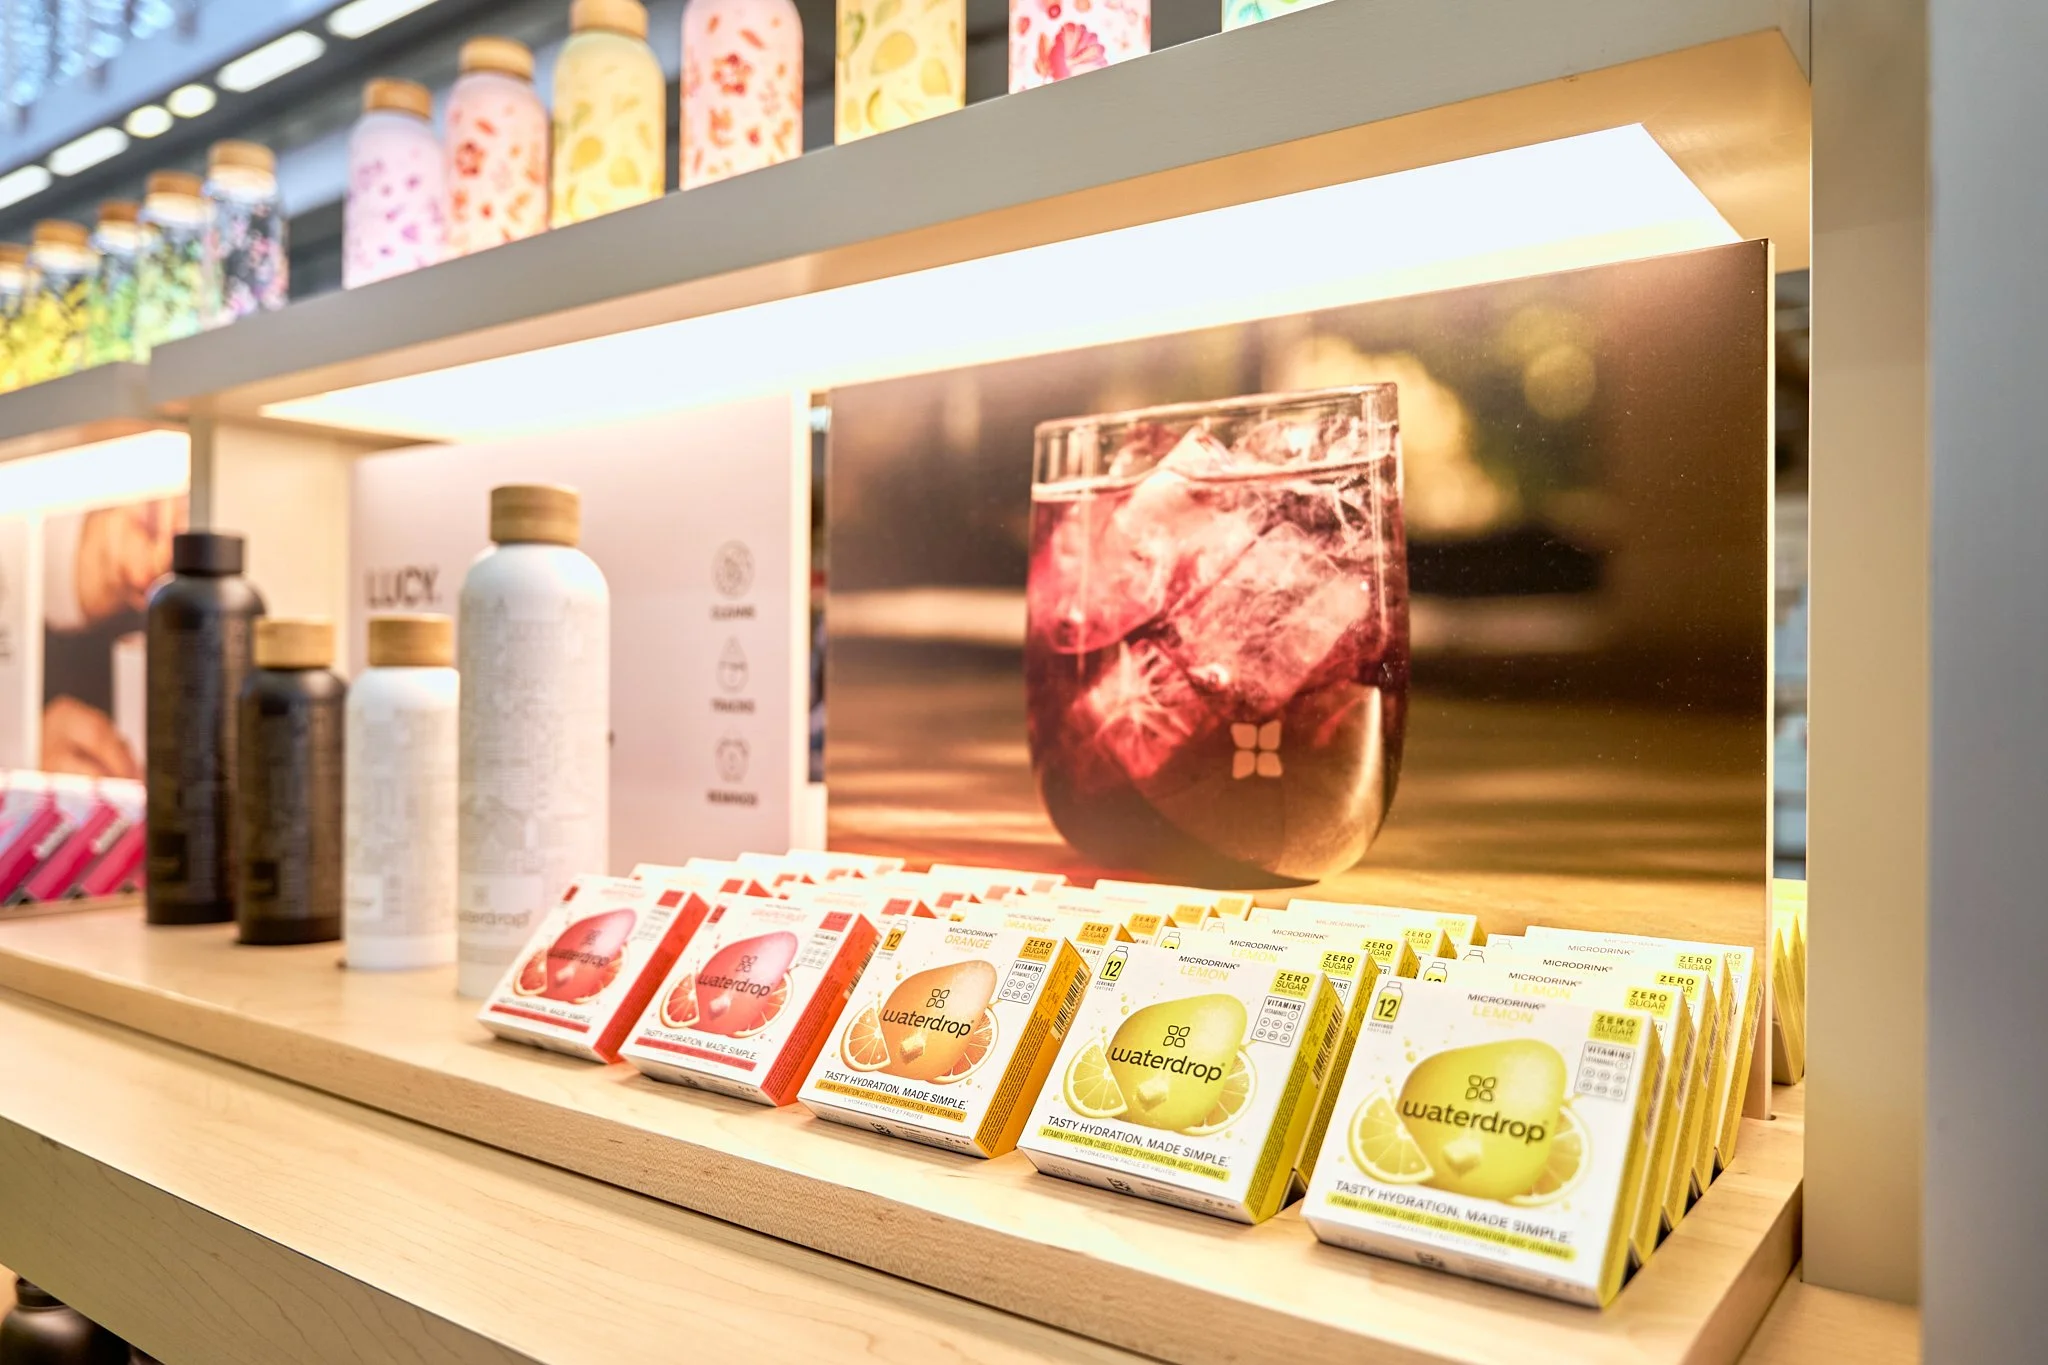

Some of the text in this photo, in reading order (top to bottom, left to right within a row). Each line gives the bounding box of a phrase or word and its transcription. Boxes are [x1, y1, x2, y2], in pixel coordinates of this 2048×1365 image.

[1082, 930, 1106, 940] SUGAR
[1085, 925, 1109, 933] ZERO
[1405, 930, 1432, 939] ZERO
[886, 933, 901, 948] 12
[944, 934, 993, 950] ORANGE
[1028, 940, 1053, 949] ZERO
[1365, 941, 1393, 951] ZERO
[1024, 946, 1050, 956] SUGAR
[1325, 953, 1355, 964] ZERO
[1680, 955, 1712, 965] ZERO
[1015, 963, 1043, 973] VITAMINS
[1105, 960, 1122, 977] 12
[1180, 965, 1231, 981] LEMON
[1322, 961, 1353, 972] SUGAR
[1678, 963, 1711, 972] SUGAR
[1279, 973, 1310, 984] ZERO
[1660, 975, 1694, 986] ZERO
[698, 972, 772, 999] waterdrop
[1276, 980, 1307, 992] SUGAR
[1513, 982, 1571, 999] LEMON
[1631, 990, 1668, 1002] ZERO
[1267, 999, 1302, 1012] VITAMINS
[1377, 998, 1397, 1019] 12
[1629, 998, 1666, 1010] SUGAR
[1472, 1005, 1535, 1024] LEMON
[1597, 1014, 1635, 1027] ZERO
[883, 1009, 972, 1039] waterdrop
[1595, 1022, 1633, 1036] SUGAR
[705, 1041, 728, 1053] MADE
[1588, 1045, 1631, 1060] VITAMINS
[1111, 1047, 1223, 1084] waterdrop
[824, 1070, 850, 1083] TASTY
[850, 1076, 900, 1096] HYDRATION,
[902, 1087, 930, 1102] MADE
[819, 1081, 836, 1092] VITAMIN
[924, 1104, 937, 1115] AVEC
[937, 1108, 964, 1121] VITAMINES
[1403, 1100, 1546, 1145] waterdrop
[1048, 1115, 1080, 1131] TASTY
[1080, 1122, 1144, 1148] HYDRATION,
[1147, 1138, 1181, 1155] MADE
[1042, 1128, 1064, 1140] VITAMIN
[1064, 1133, 1093, 1147] HYDRATION
[1094, 1140, 1111, 1151] CUBES
[1115, 1144, 1133, 1156] CUBES
[1177, 1160, 1193, 1171] AVEC
[1193, 1164, 1226, 1180] VITAMINES
[1336, 1180, 1375, 1197] TASTY
[1377, 1190, 1460, 1220] HYDRATION,
[1465, 1209, 1509, 1229] MADE
